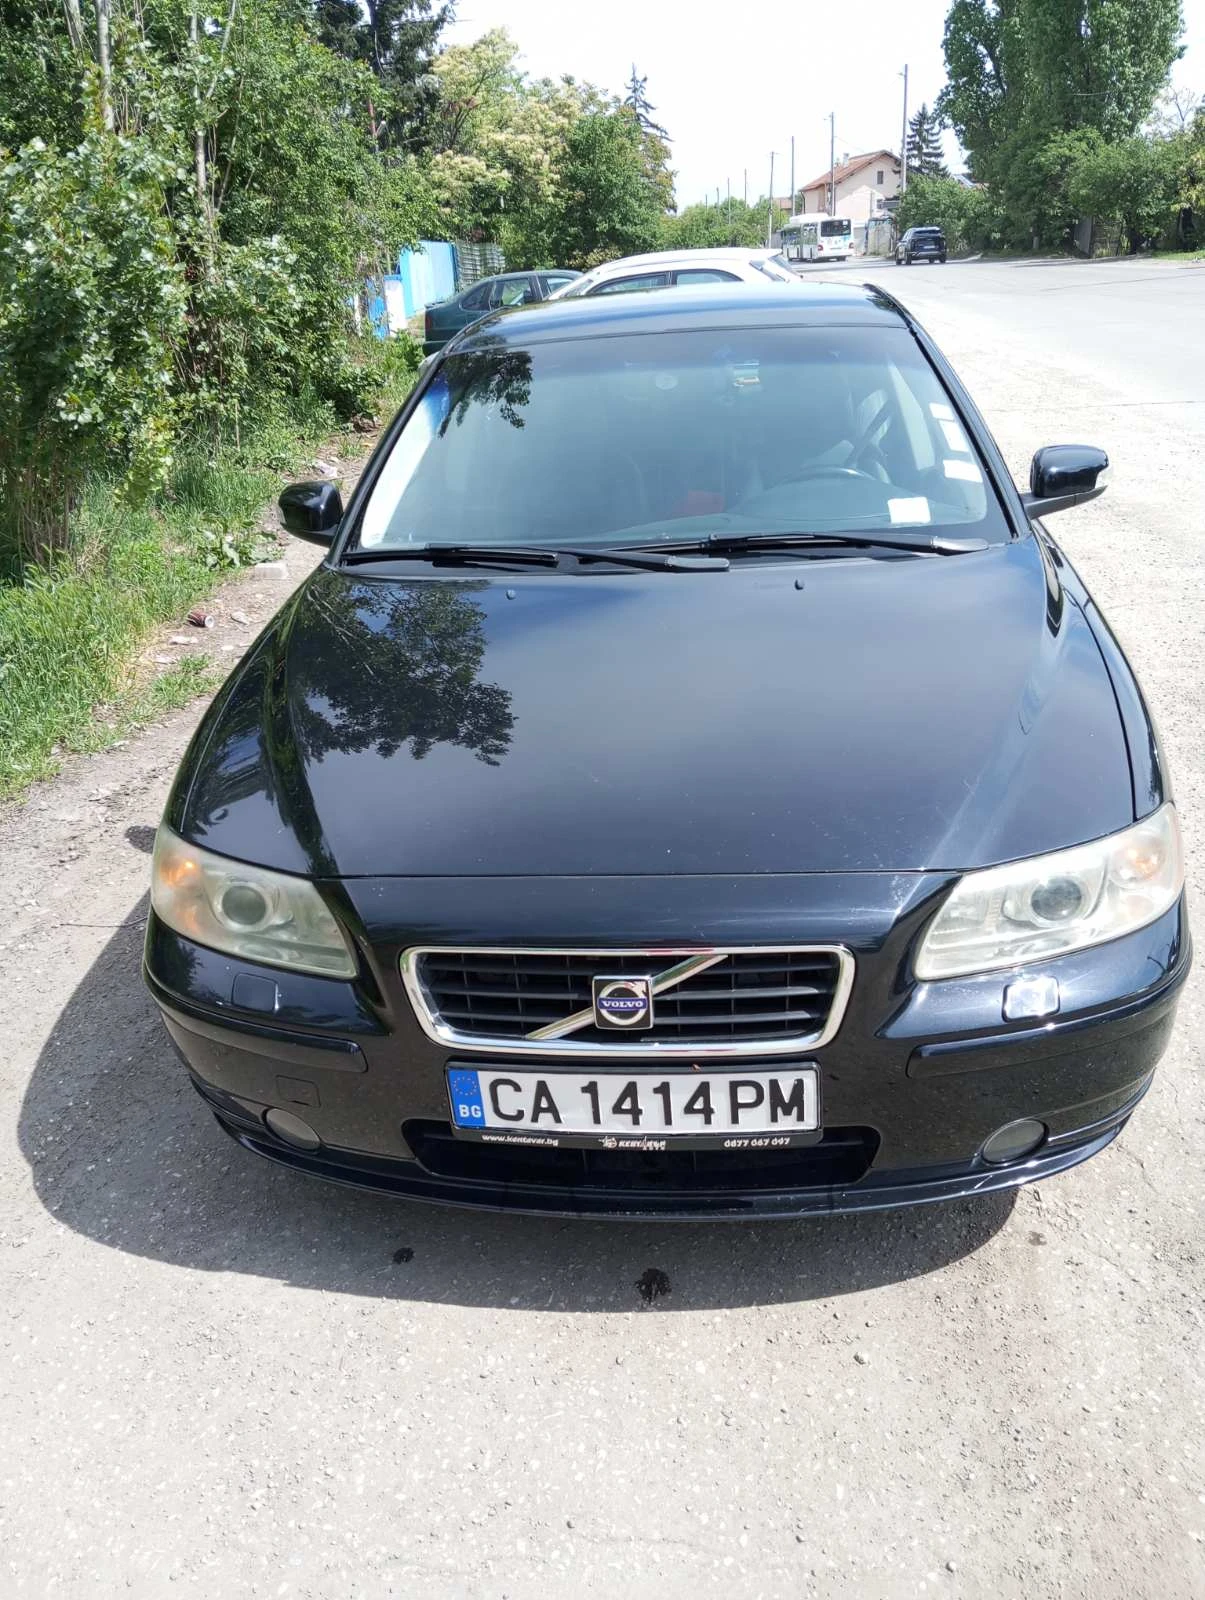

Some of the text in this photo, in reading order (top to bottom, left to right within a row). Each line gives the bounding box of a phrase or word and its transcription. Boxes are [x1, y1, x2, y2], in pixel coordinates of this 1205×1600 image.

[601, 1000, 644, 1008] VOLVO
[489, 1078, 805, 1126] CA 1414 PM
[459, 1104, 482, 1118] BG
